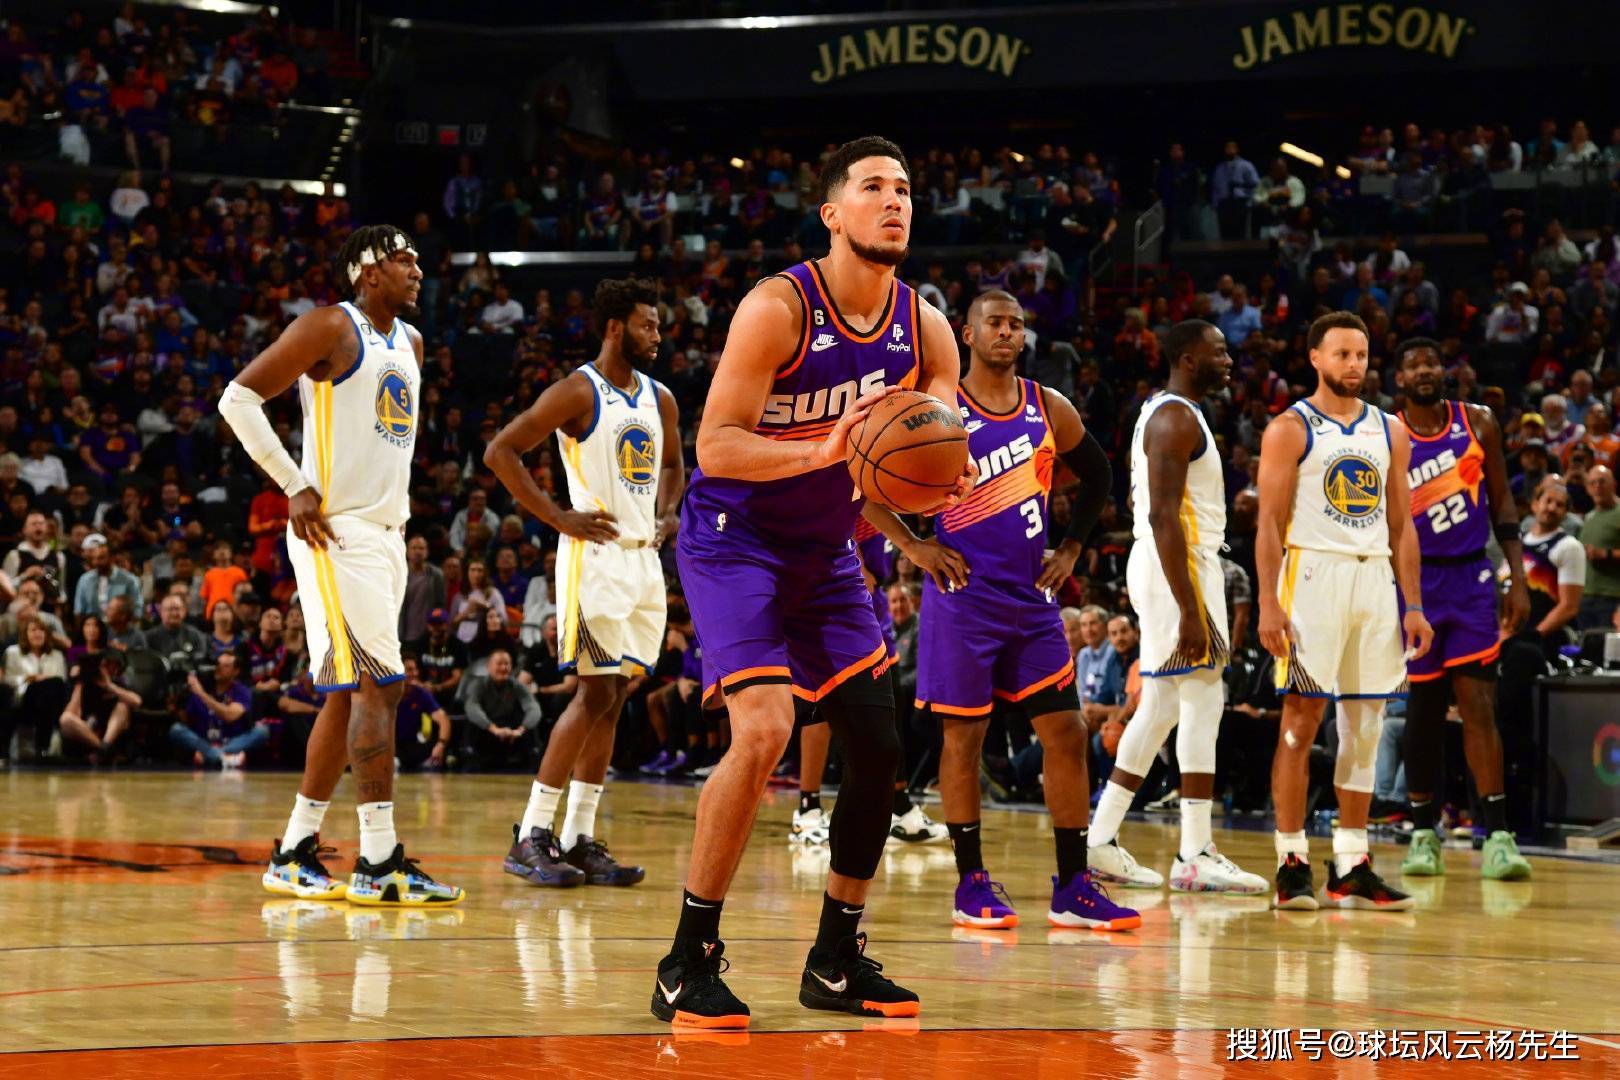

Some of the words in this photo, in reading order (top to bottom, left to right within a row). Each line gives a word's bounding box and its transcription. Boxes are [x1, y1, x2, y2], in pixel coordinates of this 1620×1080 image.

[1232, 4, 1466, 69] JAMESON
[811, 24, 1022, 84] JAMESON
[814, 309, 824, 326] 6
[816, 333, 835, 345] NIKE
[887, 342, 911, 353] PayPal
[400, 388, 408, 408] 5
[1324, 447, 1353, 466] GOLDEN
[1358, 449, 1380, 467] STATE
[1354, 470, 1376, 489] 30
[1407, 448, 1457, 490] UNS
[1020, 498, 1043, 539] 3
[1323, 504, 1384, 529] WARRIORS
[1426, 493, 1469, 534] 22
